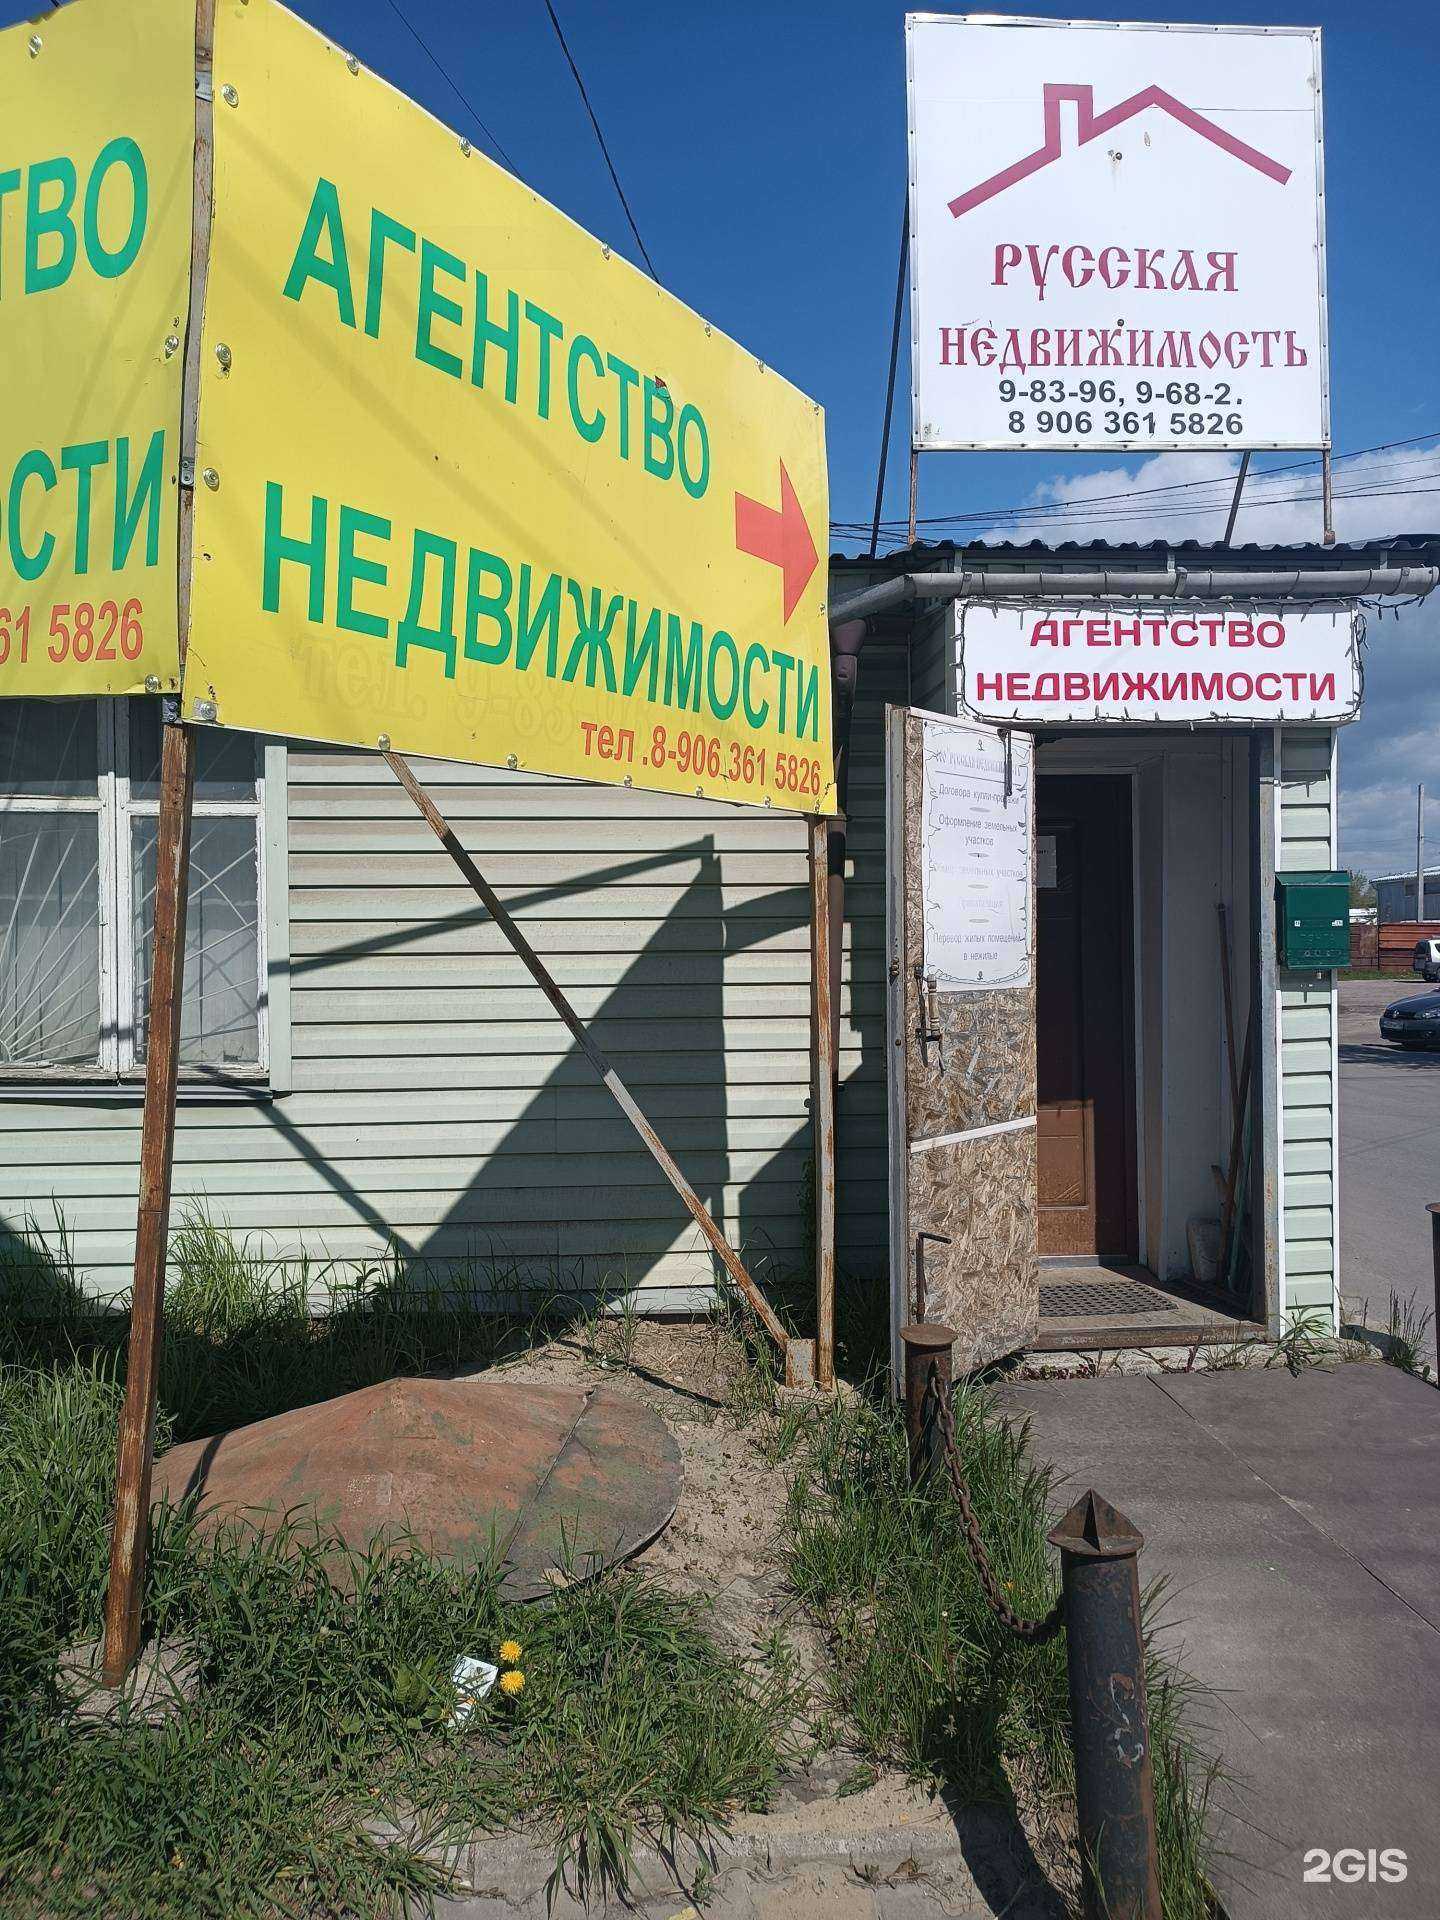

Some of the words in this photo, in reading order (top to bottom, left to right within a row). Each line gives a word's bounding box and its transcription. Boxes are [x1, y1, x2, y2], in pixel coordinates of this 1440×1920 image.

[991, 244, 1239, 301] РУССКАЯ
[282, 177, 711, 500] АГЕНТСТВО
[939, 326, 1308, 376] НЕДВИЖИМОСТЬ
[999, 380, 1125, 407] 9-83-96,
[1136, 381, 1242, 405] 9-68-2.
[1008, 411, 1025, 433] 8
[1036, 411, 1092, 433] 906
[1104, 411, 1156, 434] 361
[1170, 412, 1243, 435] 5826
[0, 430, 165, 581] СТИ
[48, 598, 143, 663] 5826
[262, 480, 820, 743] НЕДВИЖИМОСТИ
[1030, 619, 1286, 648] АГЕНТСТВО
[977, 672, 1335, 702] НЕДВИЖИМОСТИ
[729, 742, 766, 785] 361
[775, 752, 821, 795] 5826
[938, 814, 982, 829] Оформление
